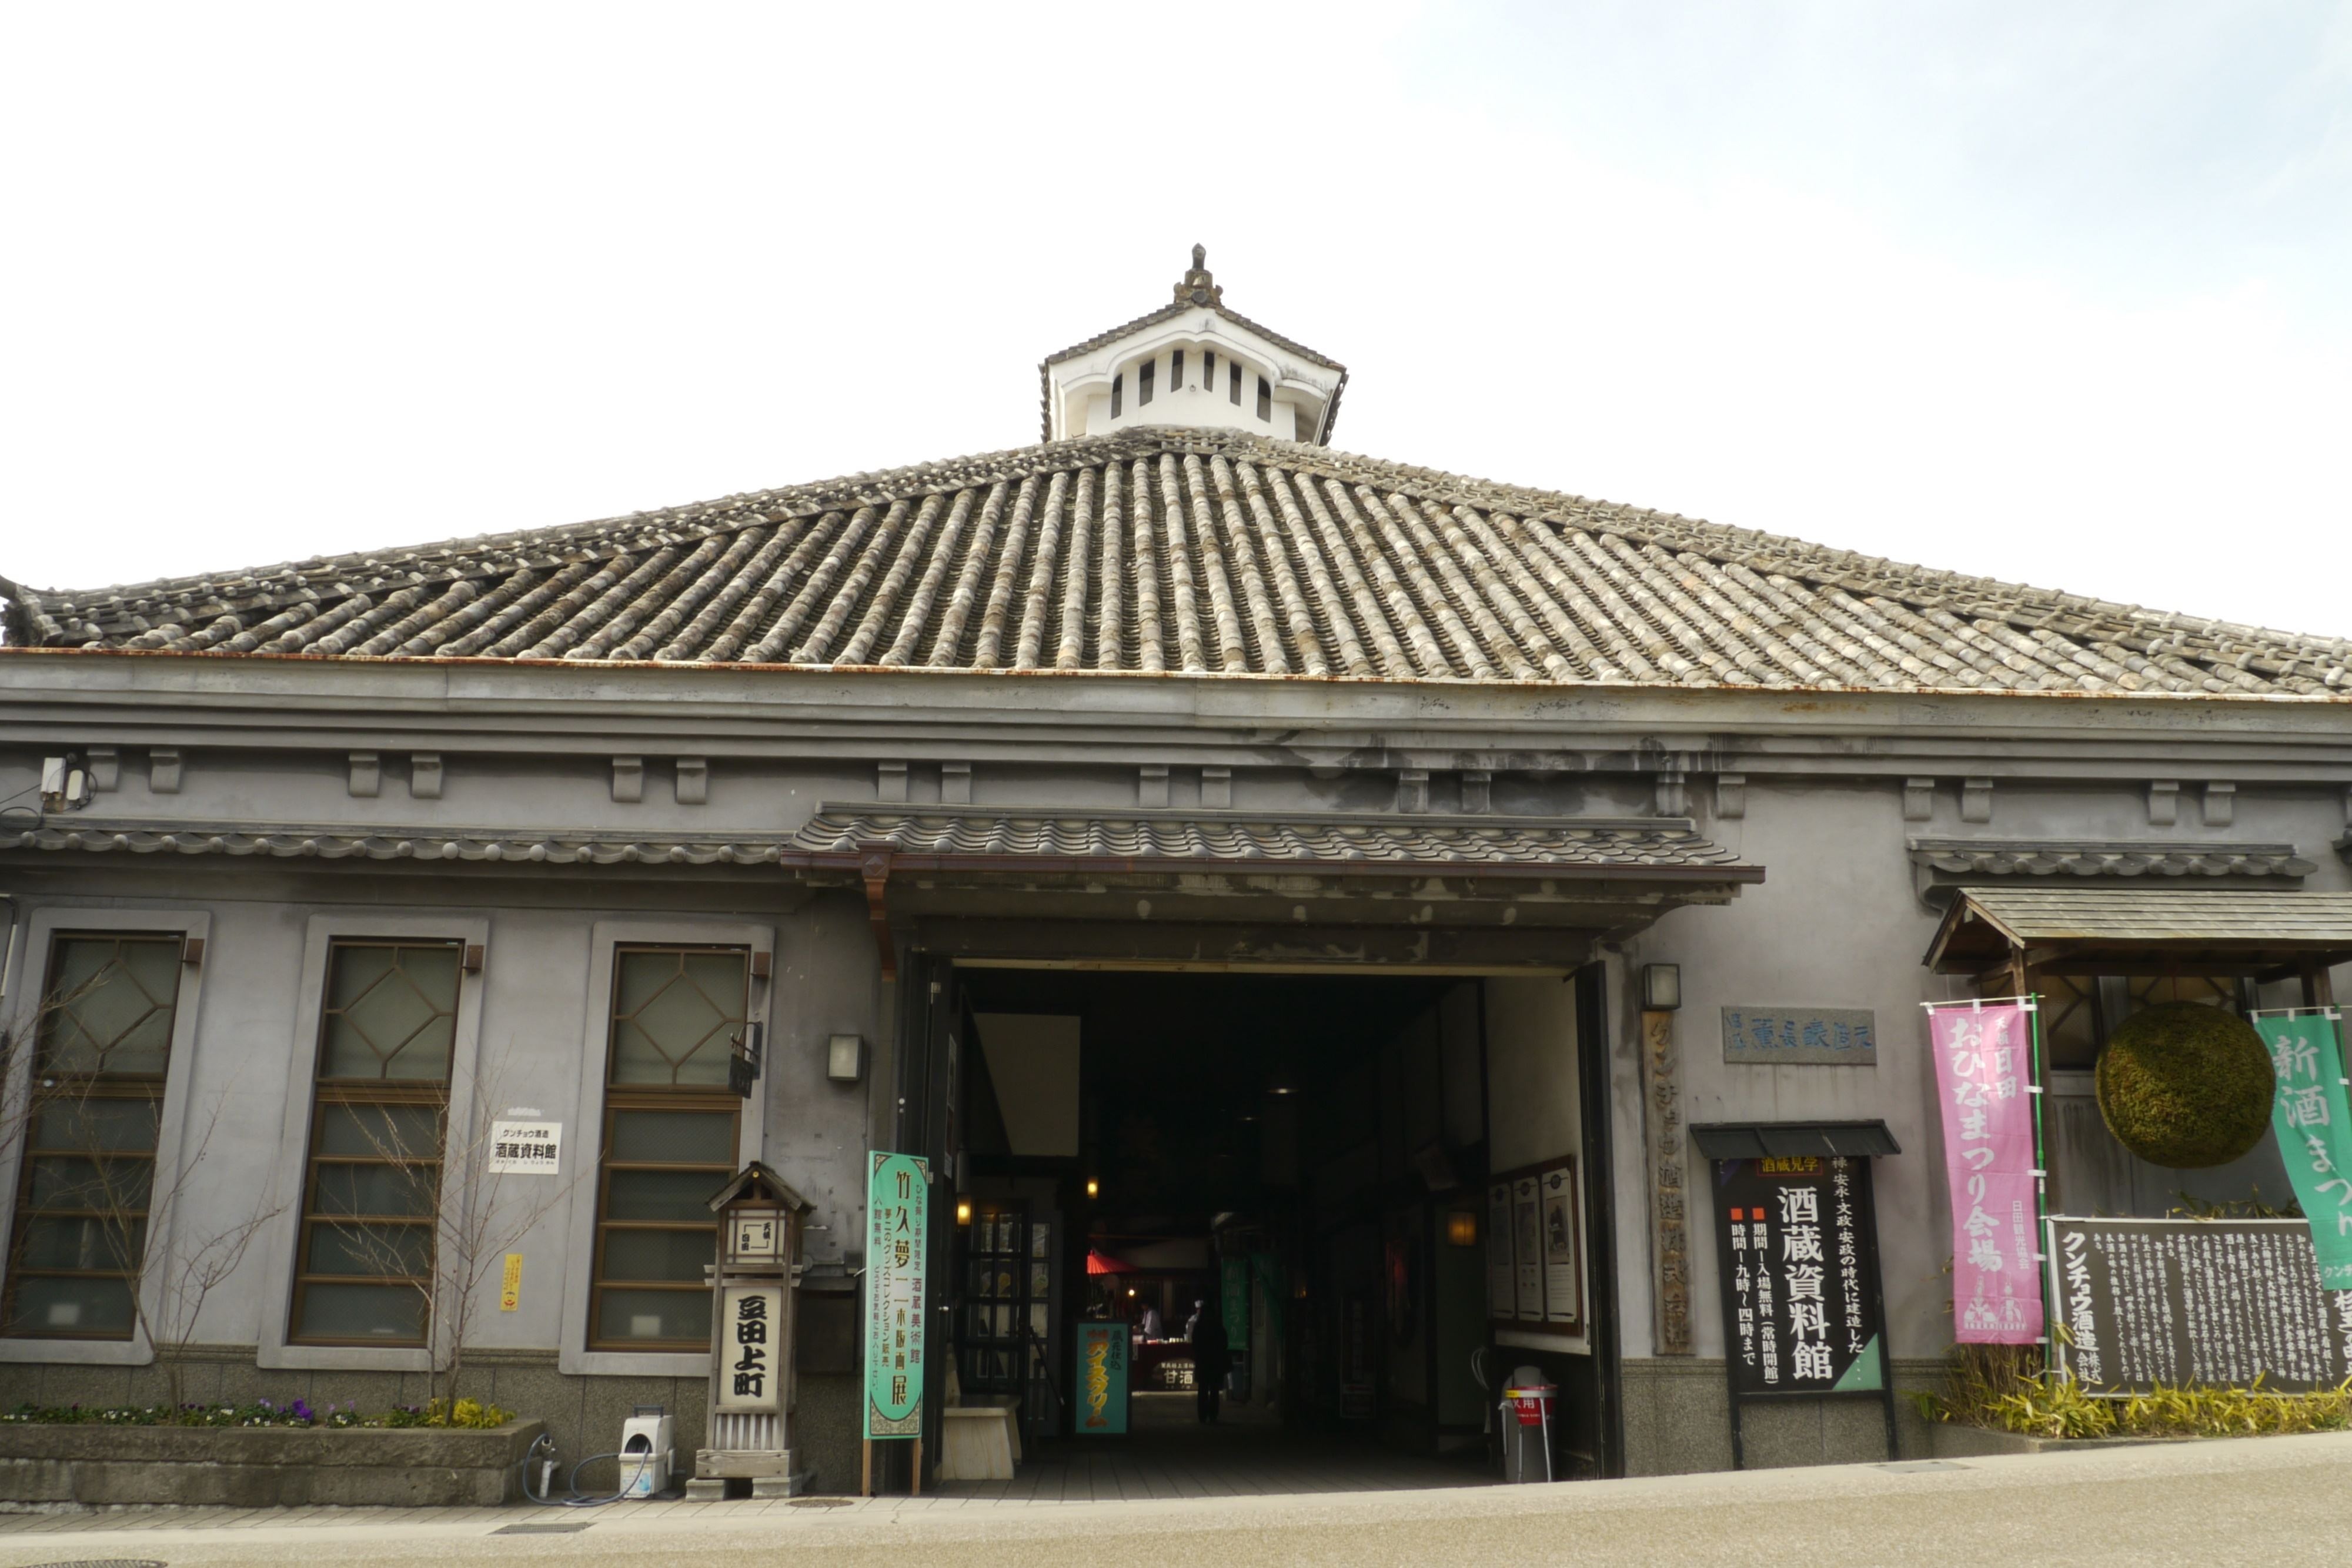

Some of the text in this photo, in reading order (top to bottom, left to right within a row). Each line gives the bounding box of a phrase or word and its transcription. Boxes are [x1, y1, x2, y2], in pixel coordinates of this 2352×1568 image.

[495, 1143, 556, 1159] 酒蔵資料館
[503, 1129, 549, 1138] クンチョウ酒造
[1762, 1156, 1818, 1172] 酒蔵見学
[1949, 1018, 2003, 1272] おひなまつり会場
[874, 1195, 882, 1245] 入館無料
[2013, 1201, 2031, 1270] 日田観光協会
[891, 1171, 911, 1406] 竹久夢二木版画展
[910, 1278, 922, 1364] 酒蔵美術館
[1776, 1186, 1833, 1380] 酒蔵資料館
[2062, 1232, 2100, 1351] クンチョウ酒造
[734, 1295, 767, 1398] 豆田上町
[1085, 1341, 1110, 1427] アイスクリーム
[1164, 1369, 1194, 1384] 甘酒
